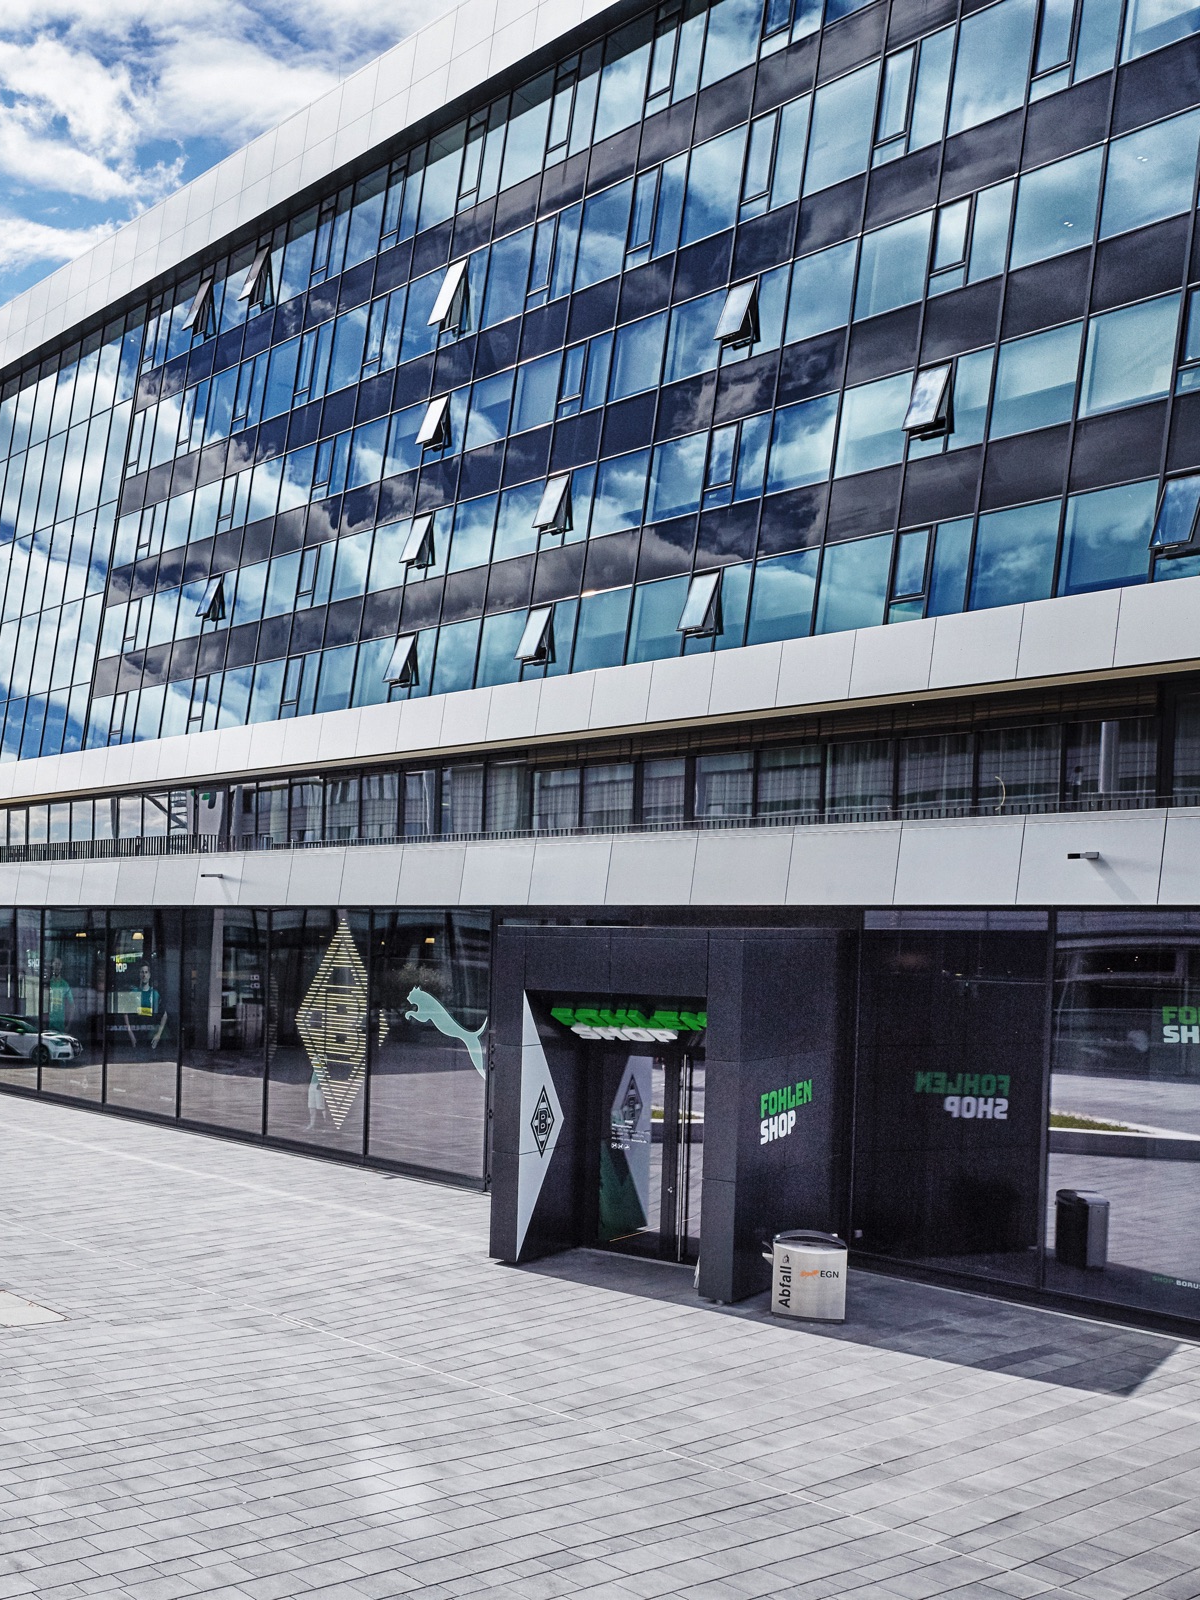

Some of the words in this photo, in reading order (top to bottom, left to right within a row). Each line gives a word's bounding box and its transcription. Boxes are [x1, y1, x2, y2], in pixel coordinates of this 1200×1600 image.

[551, 1007, 707, 1030] FOHLEN
[1162, 1006, 1200, 1025] FO
[570, 1022, 679, 1043] SHOP
[761, 1079, 812, 1118] FOHLEN
[760, 1110, 796, 1145] SHOP
[820, 1270, 839, 1278] EGN
[778, 1265, 791, 1308] Abfall
